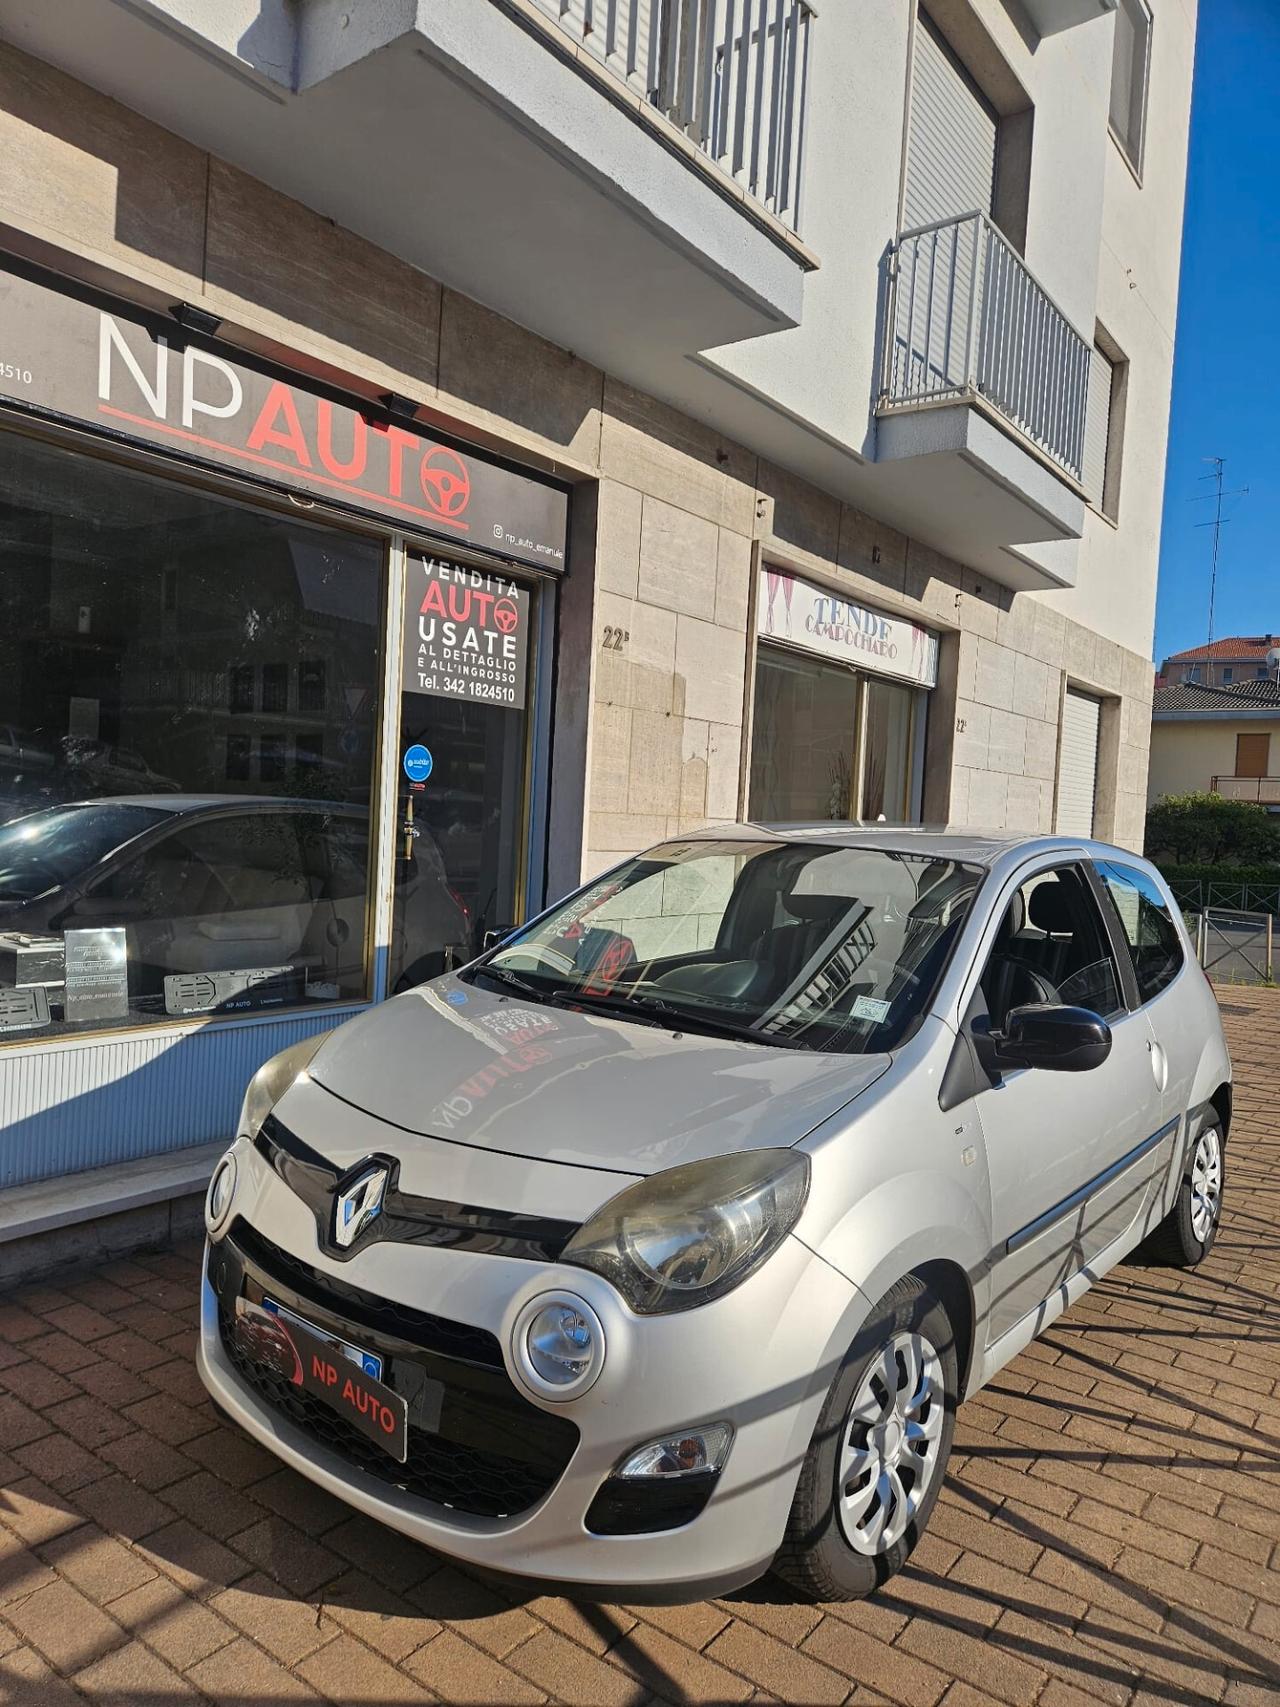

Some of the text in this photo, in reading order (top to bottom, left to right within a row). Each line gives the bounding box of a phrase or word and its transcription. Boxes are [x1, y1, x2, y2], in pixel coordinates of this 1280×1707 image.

[422, 556, 519, 599] VENDITA
[418, 616, 517, 659] USATE
[417, 657, 516, 684] E ALL'INGROSSO
[418, 643, 516, 671] AL DETTAGLIO
[417, 672, 515, 702] Tel. 342 1824510
[312, 1354, 395, 1433] NP AUTO
